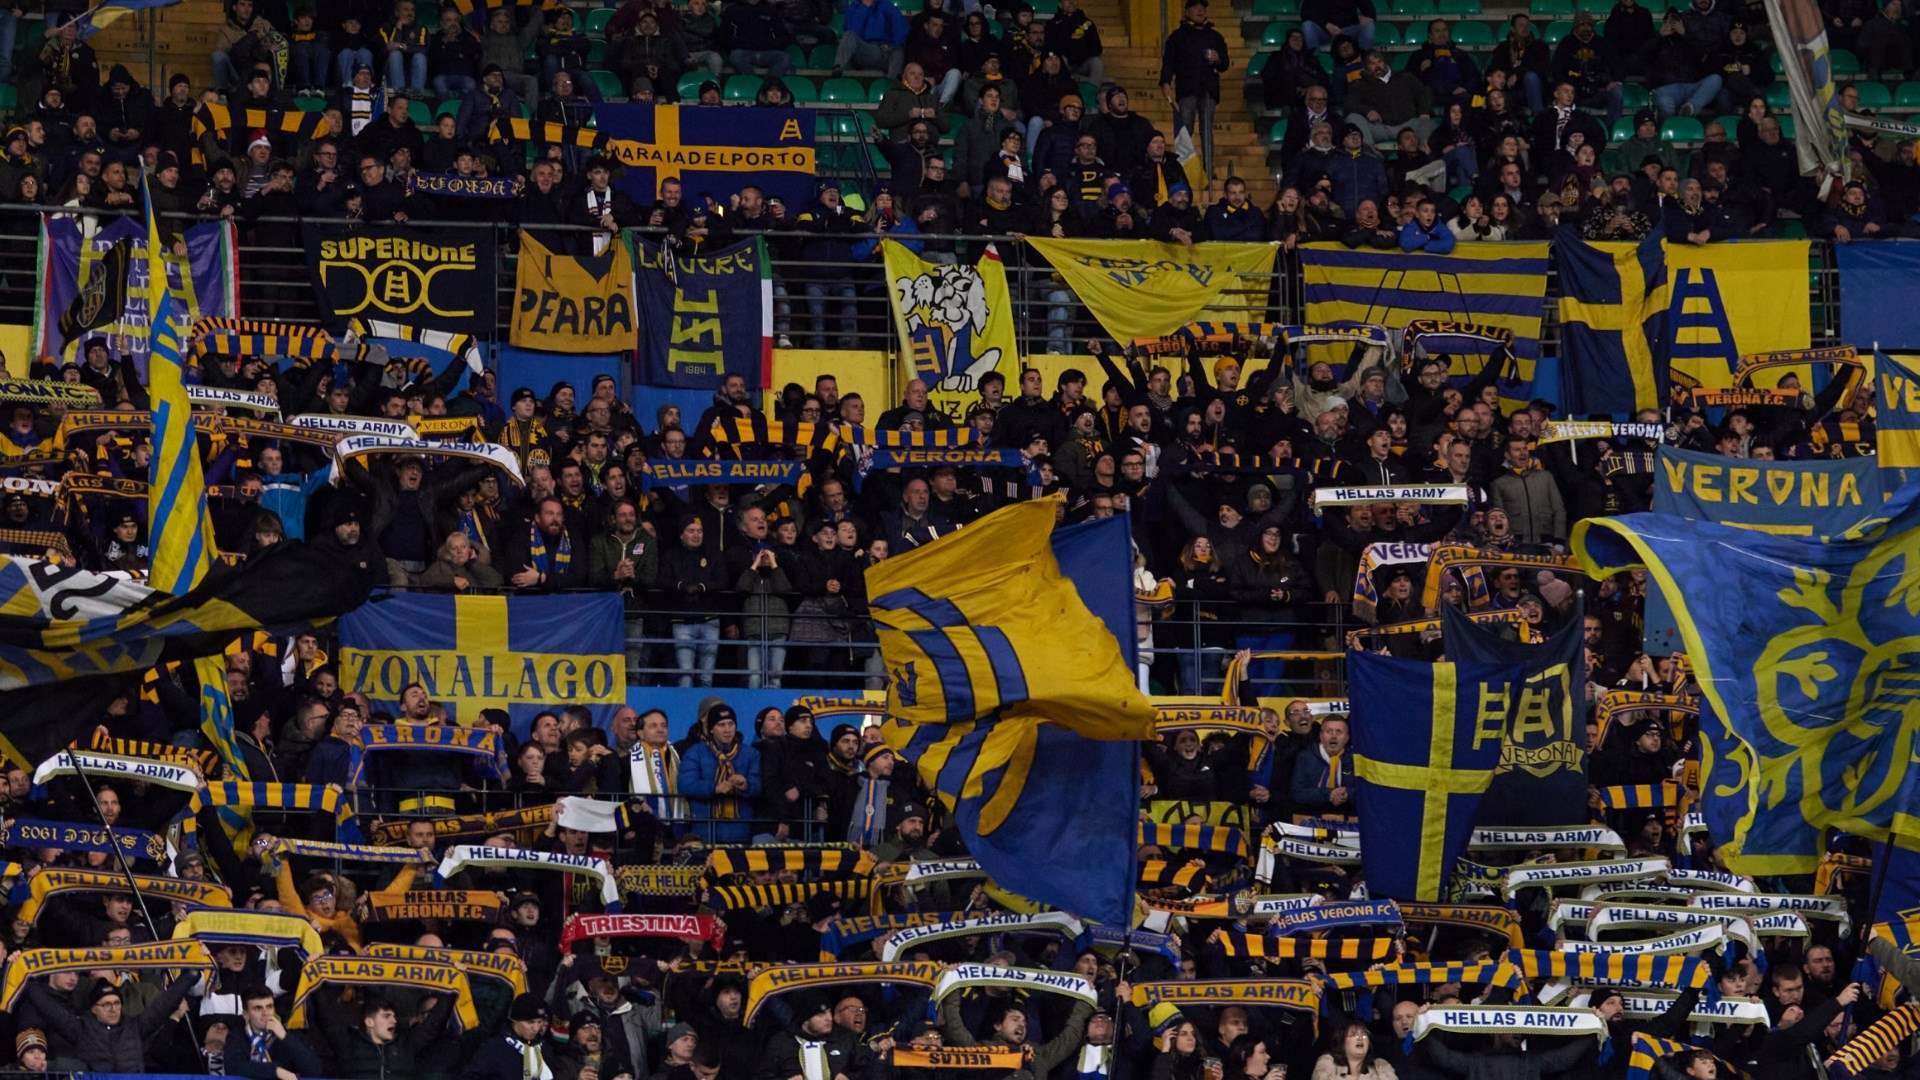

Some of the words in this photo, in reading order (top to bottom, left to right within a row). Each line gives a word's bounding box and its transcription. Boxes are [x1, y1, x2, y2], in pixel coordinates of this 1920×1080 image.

[639, 242, 753, 274] LVERE
[299, 418, 356, 430] HELLAS
[363, 422, 406, 435] ARMY
[1611, 422, 1665, 439] VERONA
[346, 437, 428, 449] HELLAS
[440, 443, 498, 455] ARMY
[891, 450, 1002, 464] VERONA
[654, 463, 720, 479] ELLAS
[730, 463, 795, 477] ARMY
[1662, 456, 1862, 507] VERONA
[1336, 489, 1396, 501] HELLAS
[1402, 488, 1446, 499] ARMY
[1372, 544, 1431, 560] VERO
[350, 653, 612, 699] ZONALAGO
[372, 726, 494, 753] ERONA
[1503, 743, 1574, 764] VERONA
[59, 755, 127, 772] HELLAS
[135, 764, 185, 781] ARMY
[1481, 832, 1547, 843] HELLAS
[1554, 831, 1602, 842] ARMY
[468, 847, 537, 862] HELLAS
[547, 851, 600, 868] ARMY
[918, 862, 986, 875] HELLA
[1527, 868, 1591, 881] HELLAS
[1599, 863, 1644, 876] ARMY
[1696, 871, 1744, 887] ARMY
[148, 878, 210, 899] ARMY
[405, 892, 467, 904] HELLAS
[1262, 898, 1311, 911] ARMY
[1700, 897, 1770, 909] HELLAS
[1779, 899, 1831, 912] ARMY
[386, 905, 455, 919] VERONA
[1320, 904, 1373, 920] VERONA
[1376, 904, 1392, 915] FC
[1609, 908, 1677, 922] HELLAS
[580, 914, 700, 935] TRIESTINA
[889, 920, 965, 947] HELLAS
[974, 913, 1032, 926] ARMY
[24, 947, 113, 969] HELLAS
[122, 944, 191, 961] ARMY
[302, 959, 384, 982] HELLAS
[393, 962, 456, 984] ARMY
[769, 967, 863, 985] HELLAS
[956, 966, 1024, 981] HELLAS
[1034, 973, 1085, 991] ARMY
[1145, 986, 1234, 1001] HELLAS
[1243, 986, 1308, 1000] ARMY
[1622, 999, 1677, 1013] ELLAS
[1445, 1012, 1516, 1025] HELLAS
[1524, 1013, 1578, 1027] ARMY
